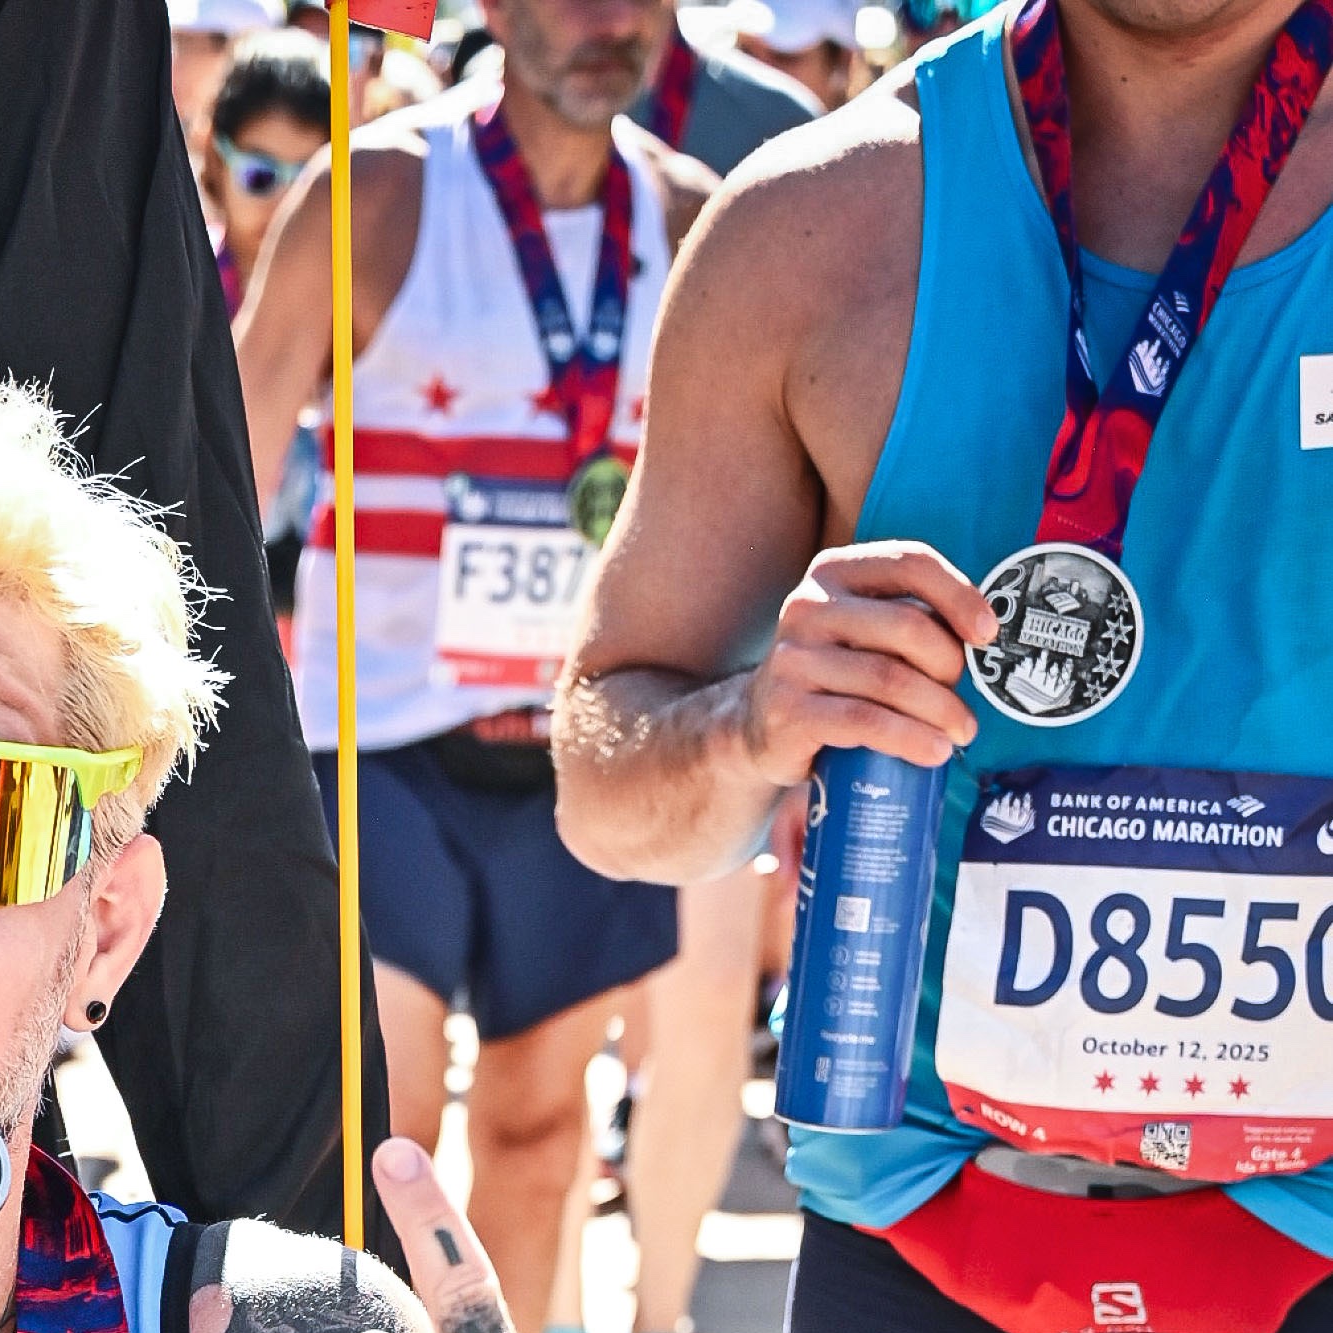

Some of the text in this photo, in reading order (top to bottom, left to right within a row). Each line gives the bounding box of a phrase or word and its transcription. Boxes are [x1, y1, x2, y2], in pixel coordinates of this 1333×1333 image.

[1050, 793, 1223, 816] BANK OF AMERICA
[1047, 815, 1284, 848] CHICAGO MARATHON
[1082, 1037, 1270, 1063] October 12, 2025
